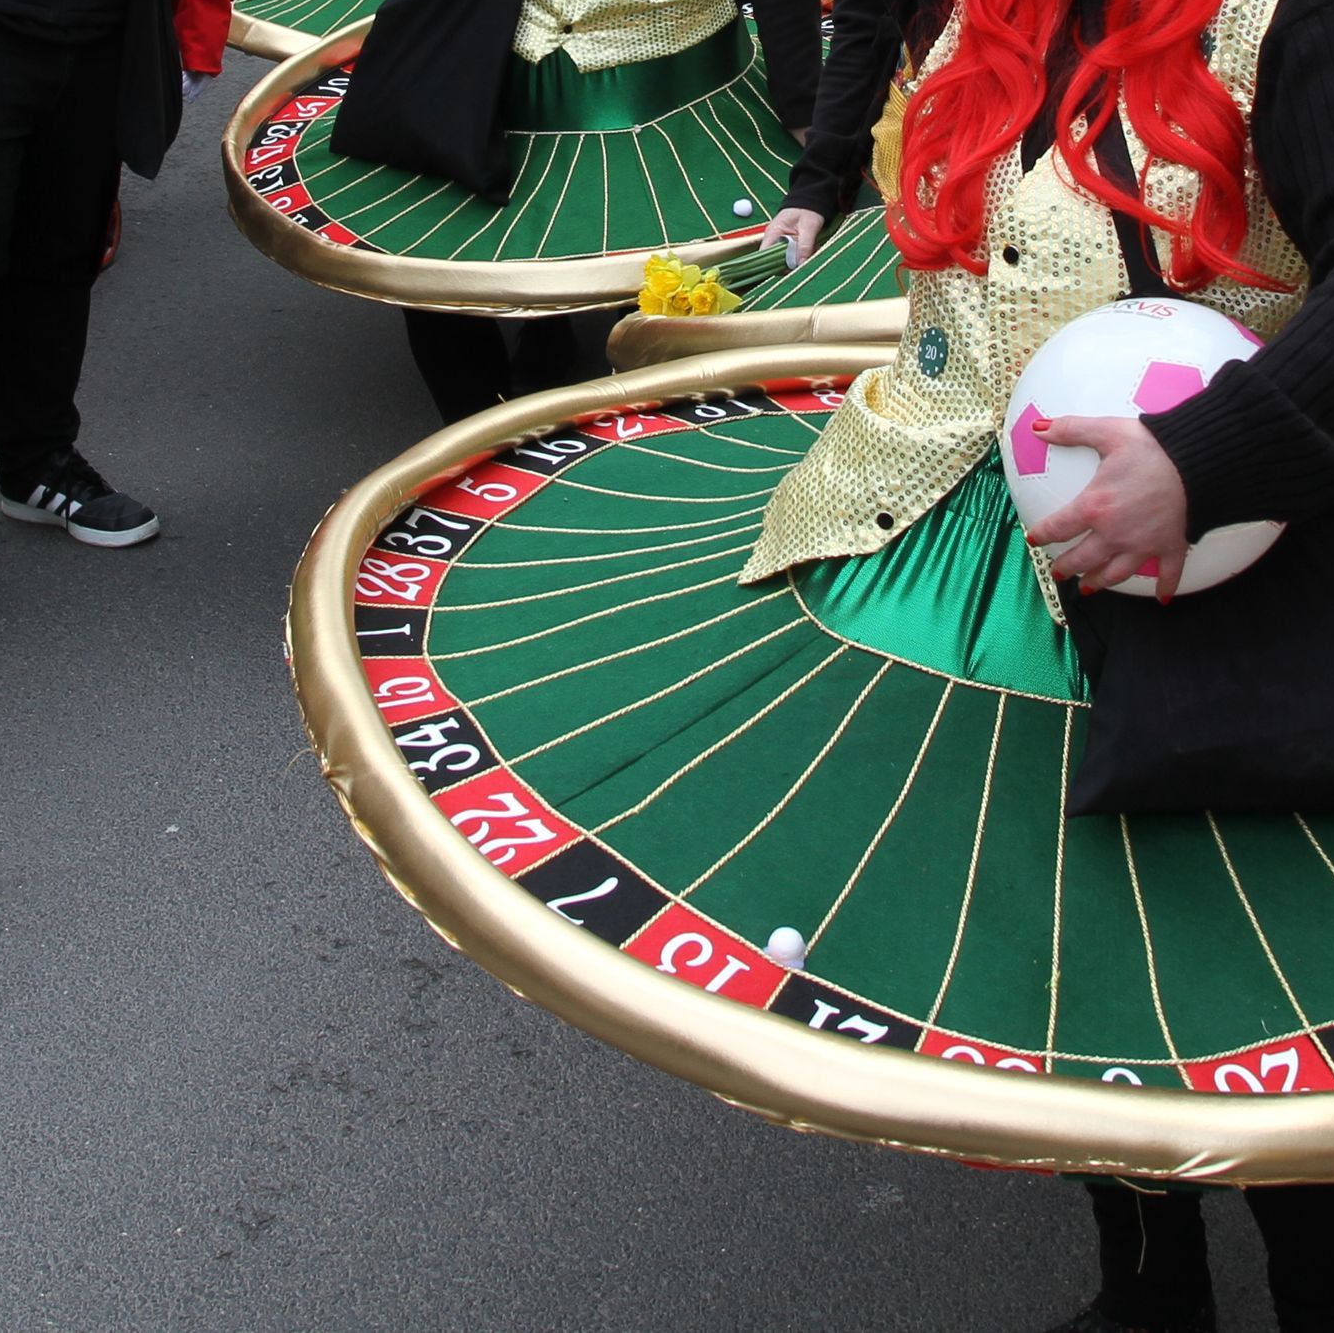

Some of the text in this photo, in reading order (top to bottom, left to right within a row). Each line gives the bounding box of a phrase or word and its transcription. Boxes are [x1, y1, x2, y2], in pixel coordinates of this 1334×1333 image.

[924, 345, 937, 360] 20
[513, 437, 588, 466] 16
[467, 476, 518, 503] 5
[384, 506, 471, 555] 37
[354, 558, 432, 601] 28
[354, 623, 412, 638] 1
[373, 676, 434, 710] 15
[393, 716, 481, 782] 34
[449, 791, 558, 866] 22
[547, 875, 620, 925] 7
